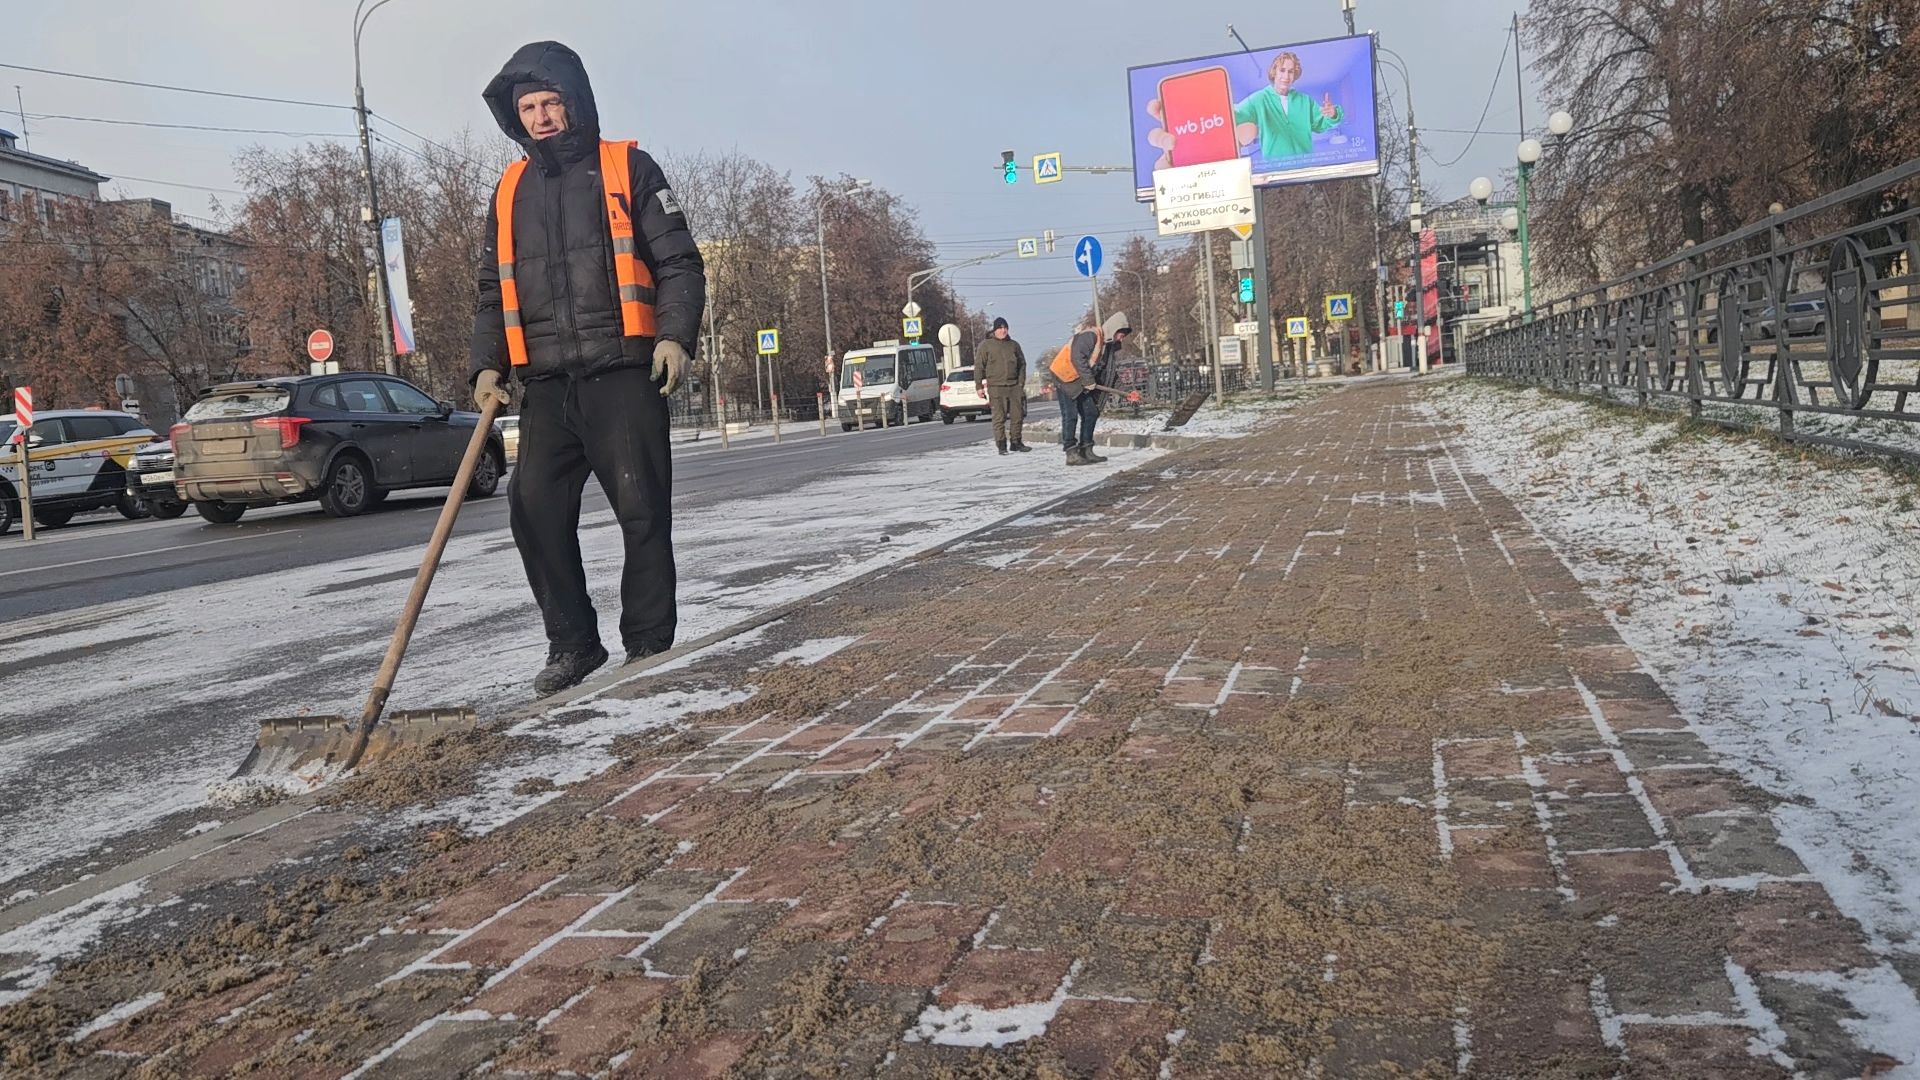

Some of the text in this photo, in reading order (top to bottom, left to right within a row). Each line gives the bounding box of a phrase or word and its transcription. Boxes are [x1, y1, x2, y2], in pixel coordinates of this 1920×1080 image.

[1175, 113, 1225, 135] wb job
[1351, 136, 1365, 147] 18+
[1170, 189, 1225, 203] РЭО ГИБДД
[1172, 203, 1239, 219] ЖУКОВСКОГО
[1173, 219, 1201, 230] улица
[1239, 324, 1258, 332] СТО
